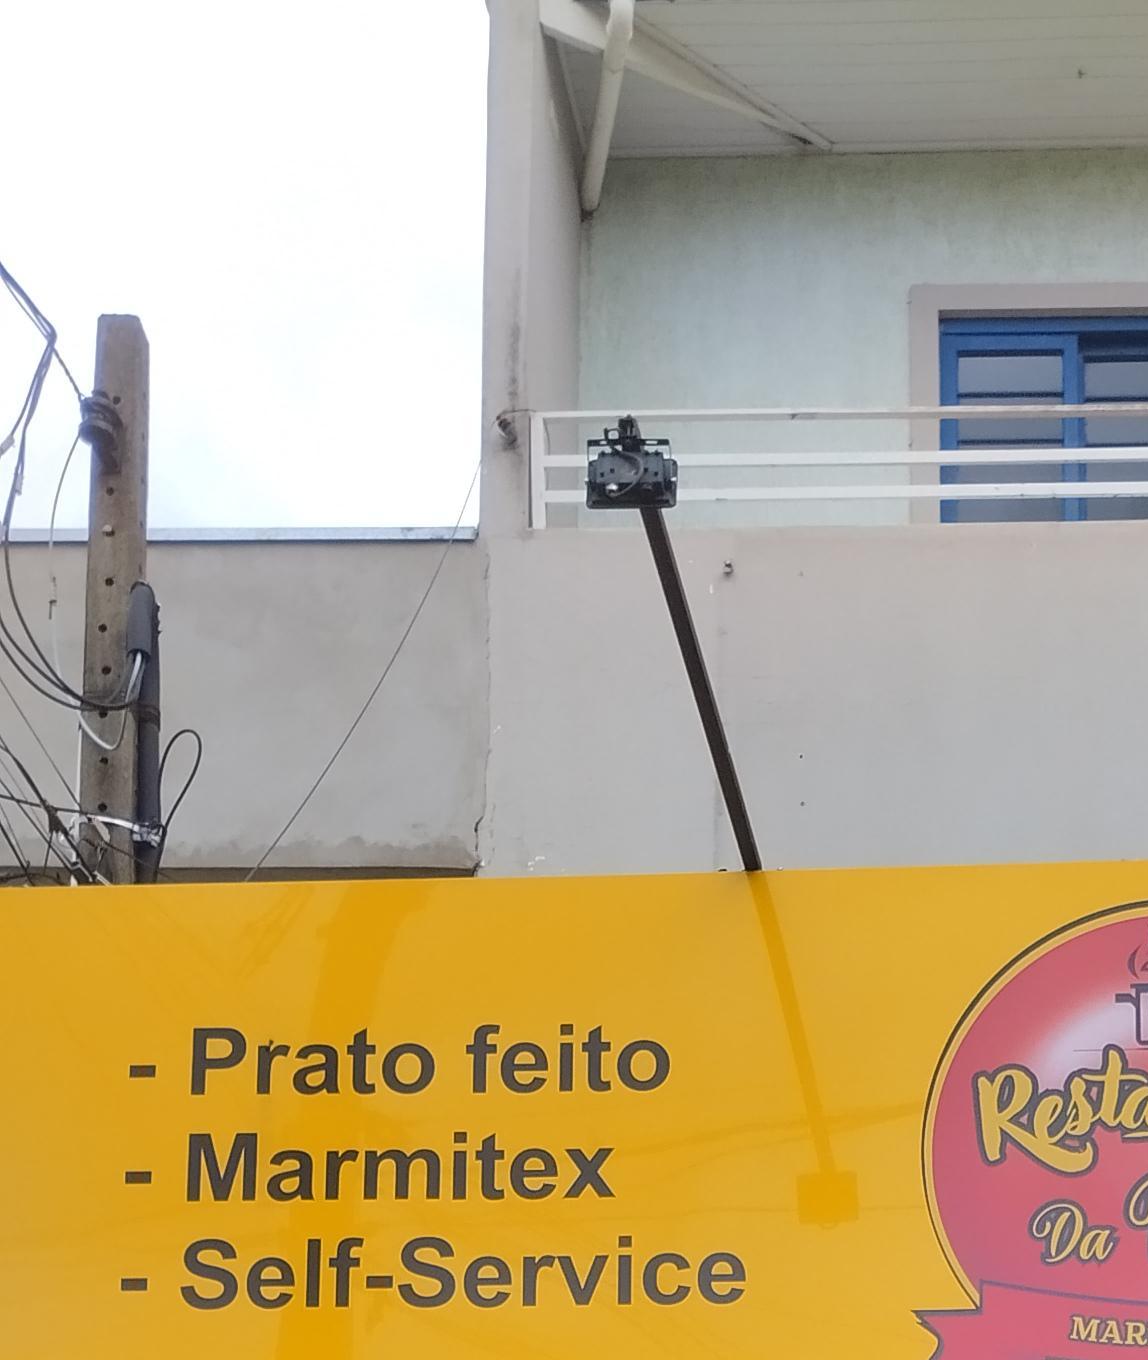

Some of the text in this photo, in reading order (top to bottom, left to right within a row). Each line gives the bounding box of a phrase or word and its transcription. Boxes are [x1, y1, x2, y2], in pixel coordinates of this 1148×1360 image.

[190, 1027, 436, 1096] Prato
[465, 1023, 671, 1094] feito
[186, 1131, 616, 1202] Marmitex
[1030, 1201, 1116, 1264] Da
[180, 1235, 747, 1310] Self-Service
